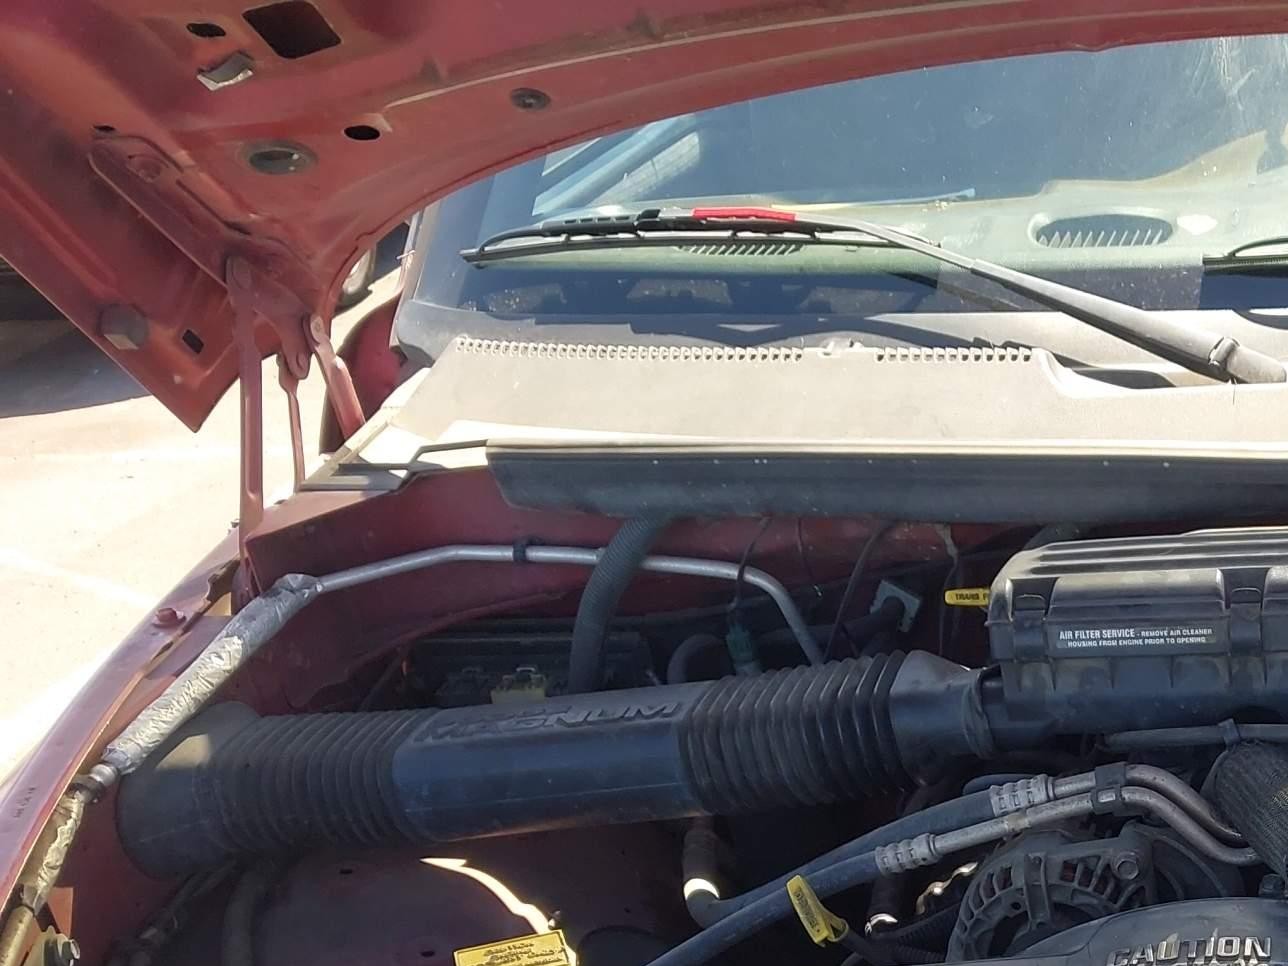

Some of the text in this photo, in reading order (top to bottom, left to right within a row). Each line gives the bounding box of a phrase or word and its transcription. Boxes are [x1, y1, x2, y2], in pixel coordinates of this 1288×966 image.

[1059, 630, 1073, 640] AIR
[1074, 629, 1101, 640] FILTER
[1102, 628, 1136, 638] SERVICE
[1169, 629, 1181, 637] AIR
[1182, 628, 1213, 636] CLEANER
[1067, 640, 1098, 648] HOUSING
[1098, 639, 1118, 647] FROM
[1144, 638, 1165, 646] PRIOR
[1165, 637, 1175, 645] TO
[1176, 637, 1206, 645] OPENING
